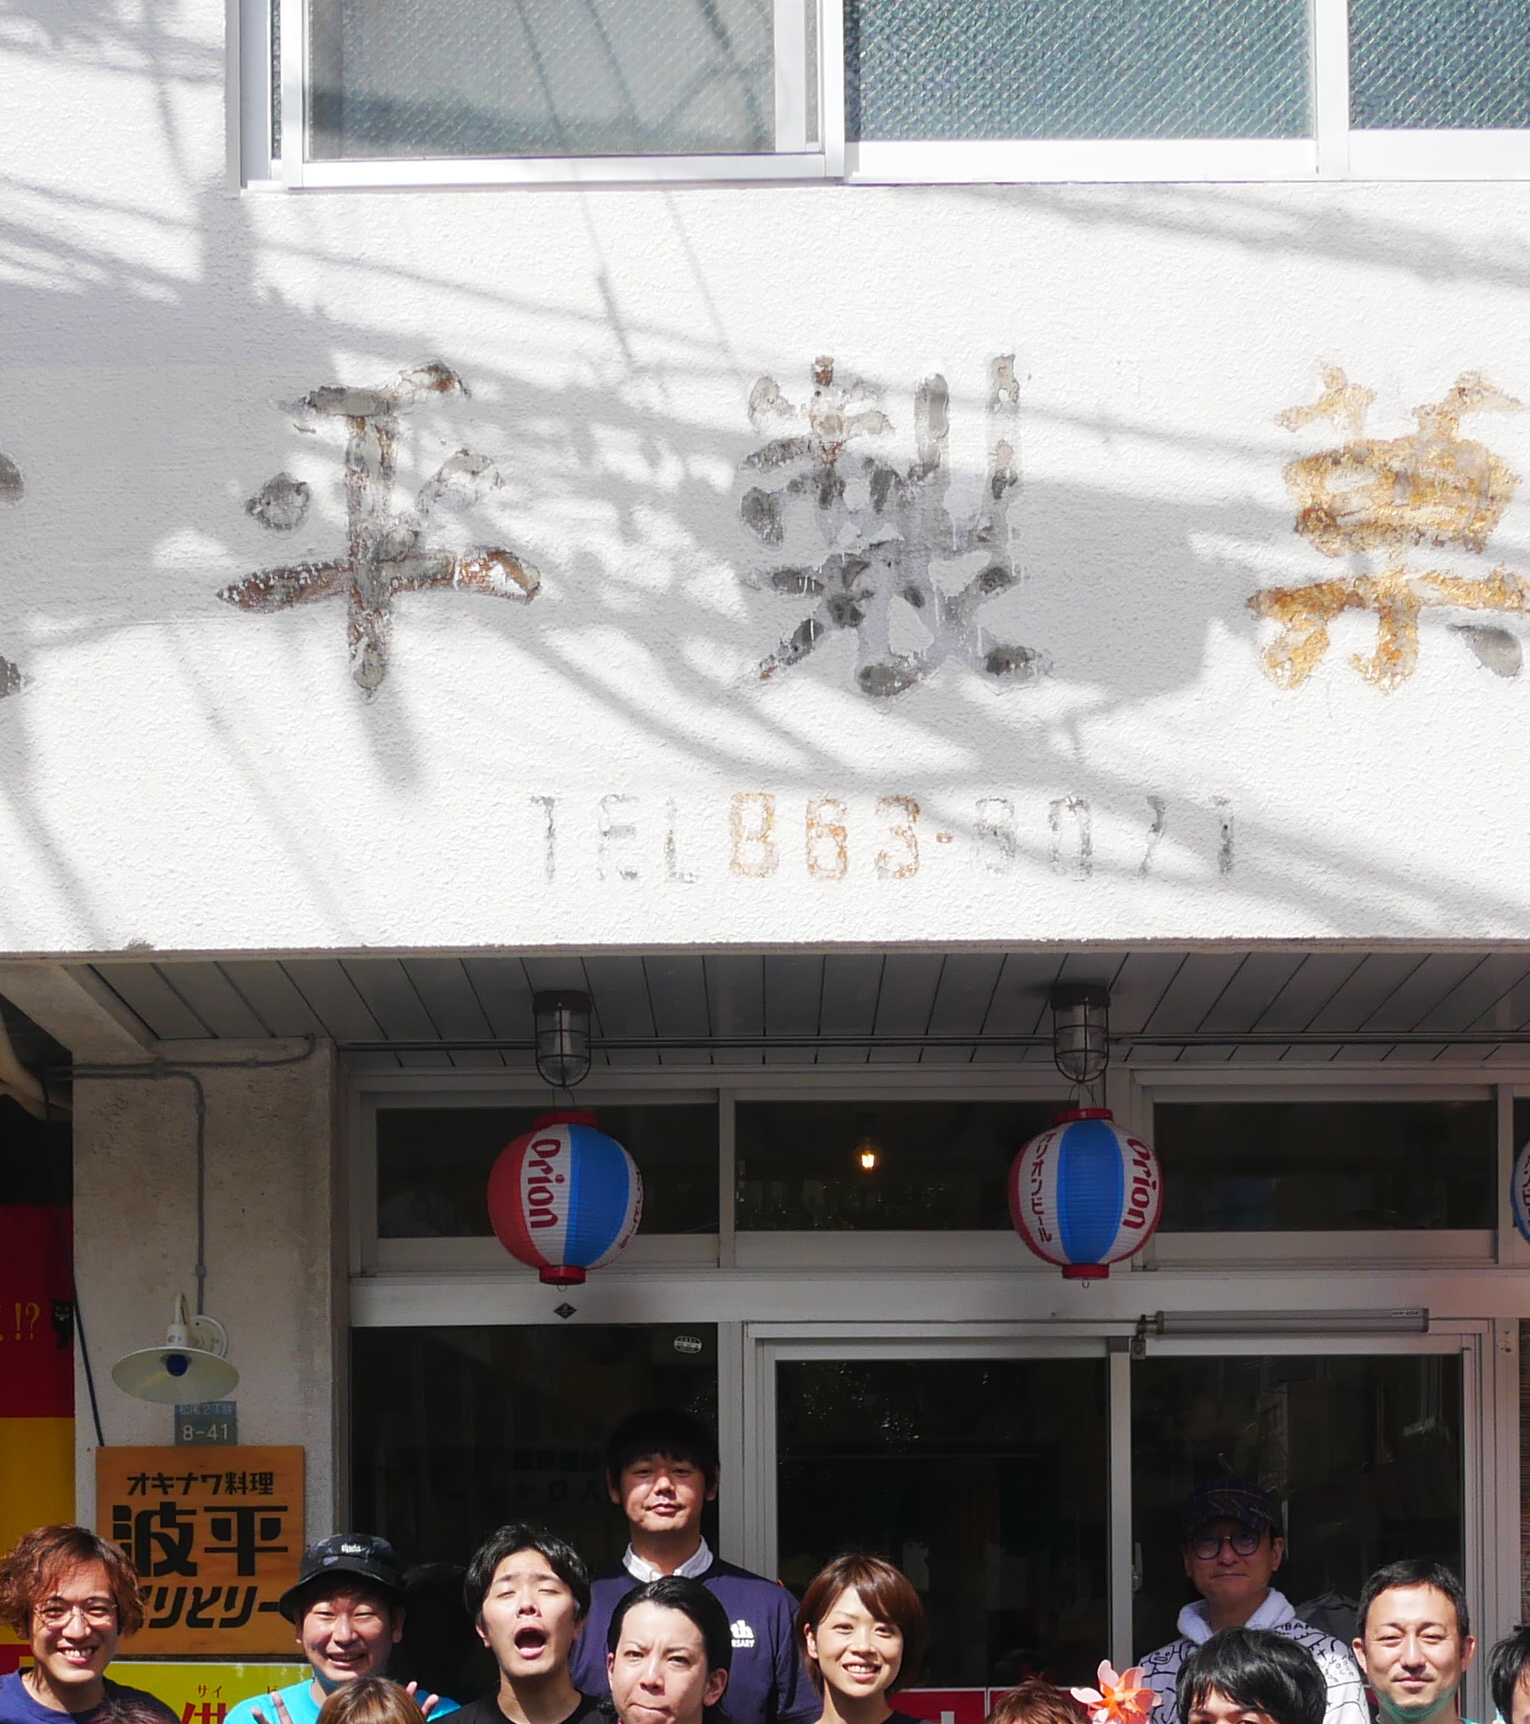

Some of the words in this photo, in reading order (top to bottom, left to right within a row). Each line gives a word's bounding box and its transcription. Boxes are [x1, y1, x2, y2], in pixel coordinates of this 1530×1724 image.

[527, 1139, 565, 1228] Orion
[1031, 1132, 1056, 1243] オリオンビール
[1122, 1138, 1157, 1229] Orion
[182, 1423, 228, 1441] 8-41
[126, 1472, 274, 1496] オキナワ料理
[112, 1502, 288, 1577] 波平
